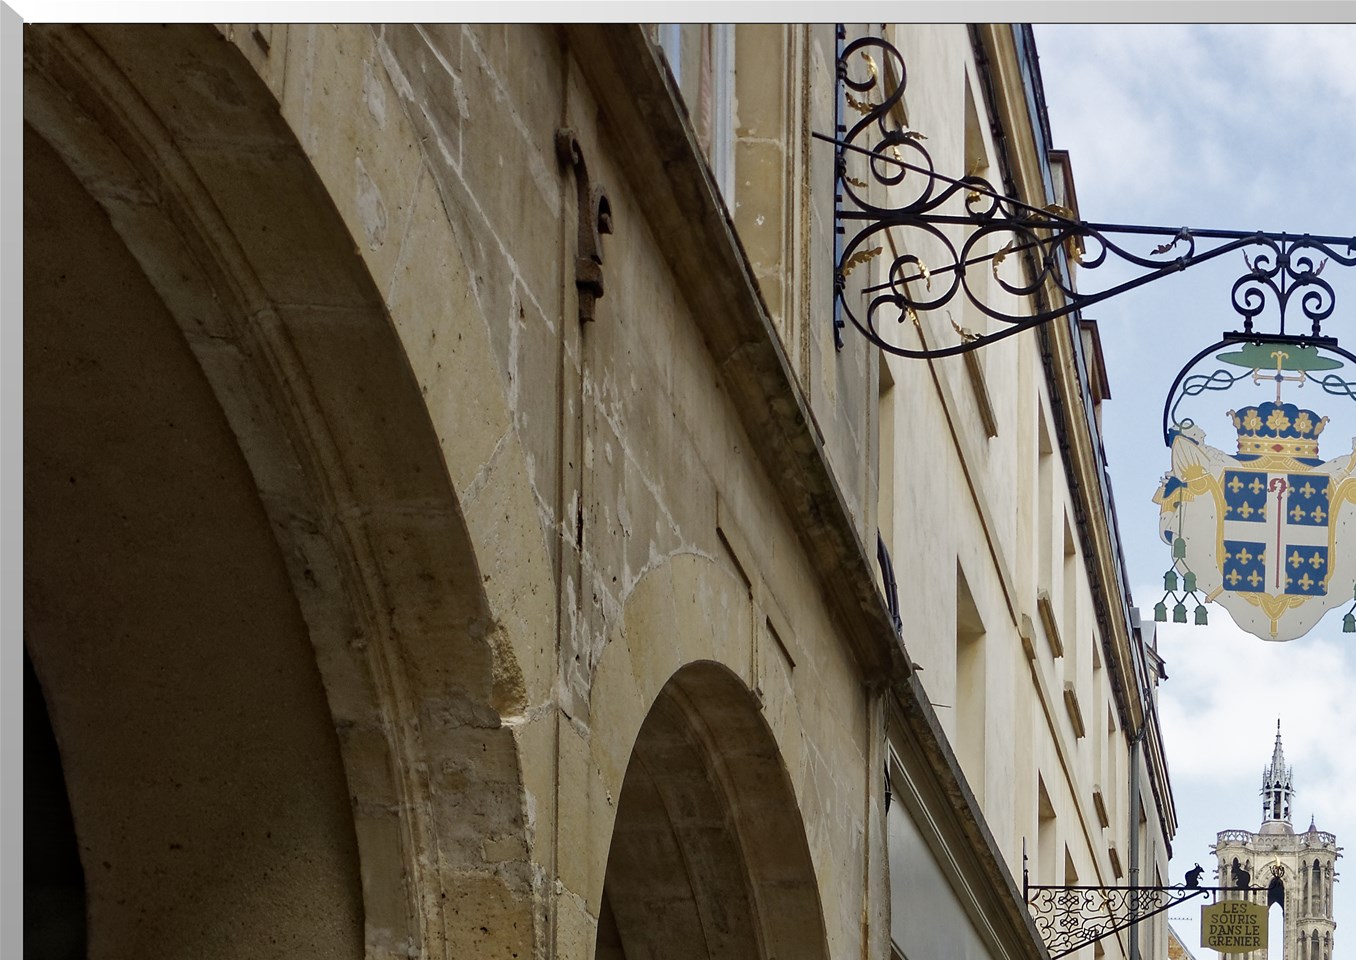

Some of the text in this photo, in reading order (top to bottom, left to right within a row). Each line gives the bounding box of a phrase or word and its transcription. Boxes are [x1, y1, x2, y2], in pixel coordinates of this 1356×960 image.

[1223, 903, 1247, 913] LES
[1211, 914, 1257, 924] SOURIS
[1209, 925, 1260, 936] DANS LE
[1208, 936, 1261, 947] GRENIER
